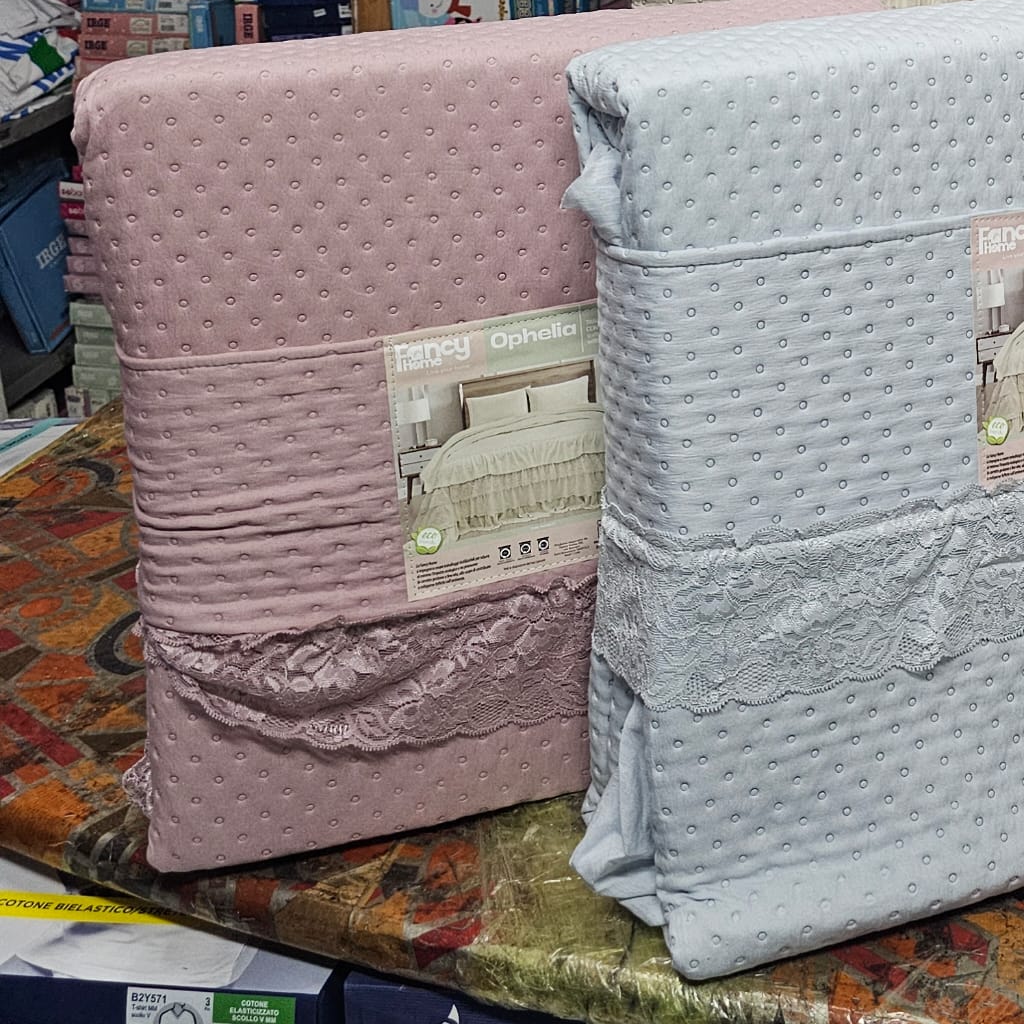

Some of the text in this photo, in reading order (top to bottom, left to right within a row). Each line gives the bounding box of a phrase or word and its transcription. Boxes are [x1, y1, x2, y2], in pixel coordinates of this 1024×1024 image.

[86, 17, 111, 28] IRGE
[84, 40, 108, 50] IRGE
[35, 233, 67, 270] IRGE
[984, 239, 1017, 255] Home
[490, 323, 577, 351] Ophelia
[395, 334, 471, 373] Fancy
[403, 354, 443, 372] Home
[0, 897, 52, 910] COTONE
[131, 992, 167, 1004] B2Y571
[205, 997, 211, 1007] 3
[241, 999, 269, 1008] COTONE
[229, 1007, 280, 1017] ELASTICIZZATO
[231, 1014, 259, 1023] SCOLLO
